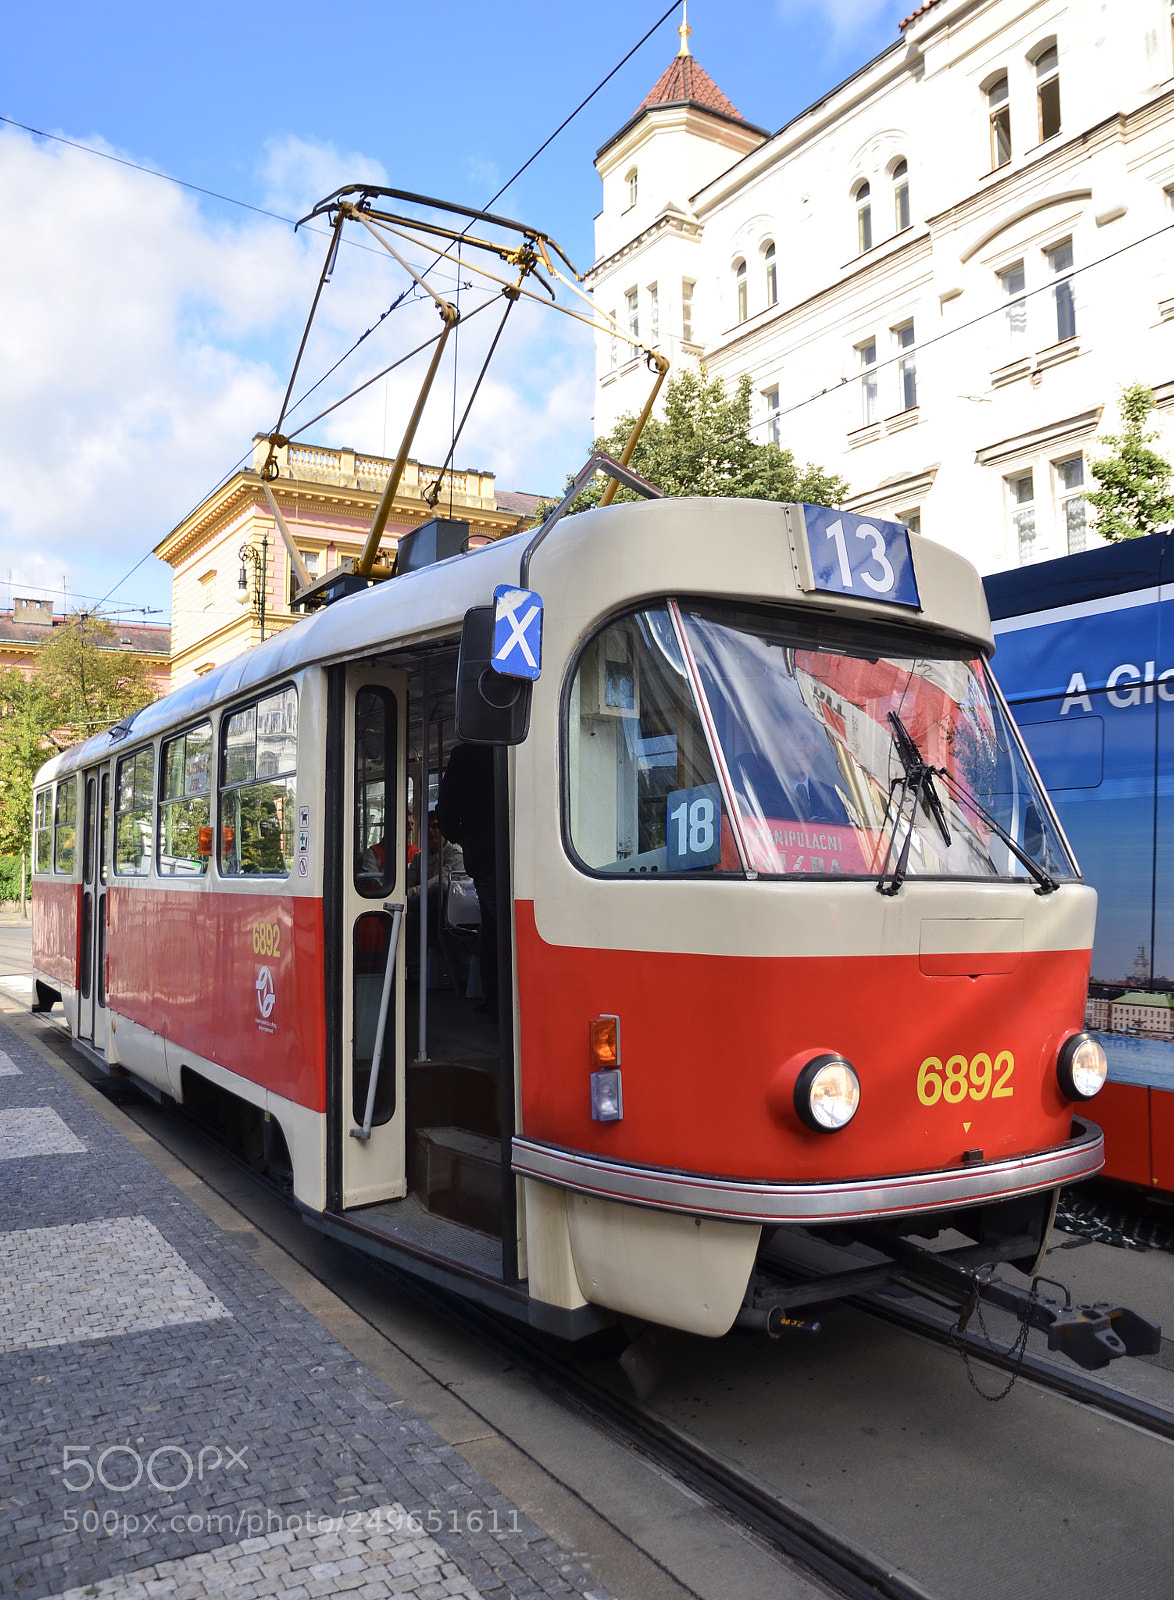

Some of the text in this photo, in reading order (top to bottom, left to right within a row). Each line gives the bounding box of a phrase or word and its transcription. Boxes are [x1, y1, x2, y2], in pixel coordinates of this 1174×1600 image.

[826, 519, 895, 593] 13
[496, 602, 540, 667] X
[1060, 672, 1093, 715] A
[671, 798, 714, 856] 18
[252, 922, 281, 957] 6892
[917, 1050, 1015, 1106] 6892
